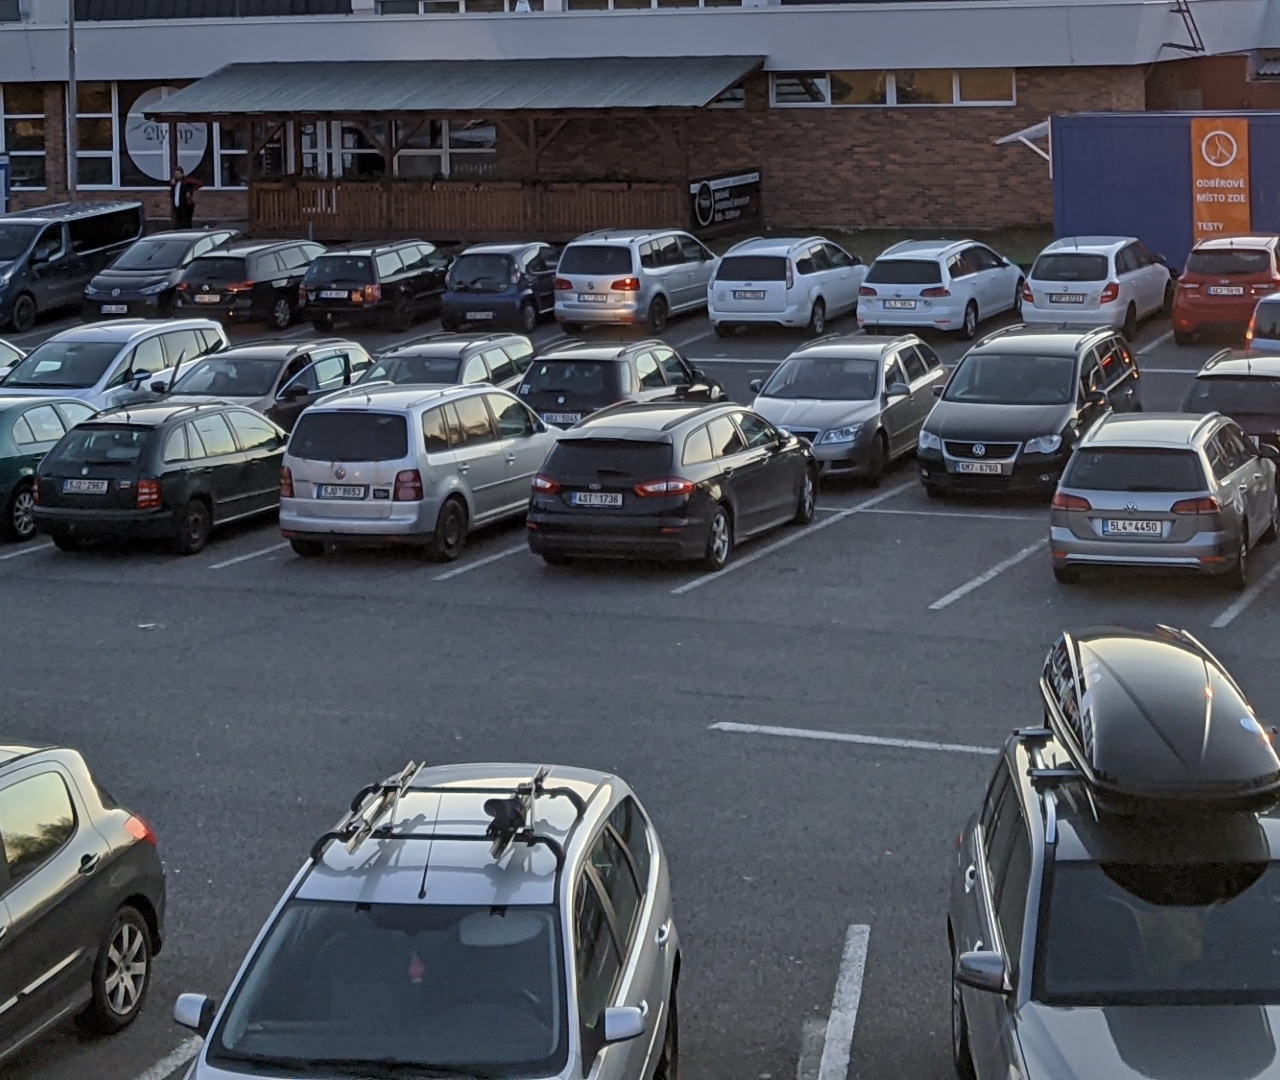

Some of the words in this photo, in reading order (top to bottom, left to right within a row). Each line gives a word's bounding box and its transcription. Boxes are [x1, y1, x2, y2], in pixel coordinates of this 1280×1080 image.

[1196, 178, 1245, 188] ODBĚROVÉ
[1196, 192, 1225, 203] MÍSTO
[1227, 194, 1246, 203] ZDE
[1197, 223, 1223, 231] TESTY
[578, 494, 592, 503] 4ST
[1110, 521, 1127, 532] 5L4
[1134, 522, 1157, 533] 4450
